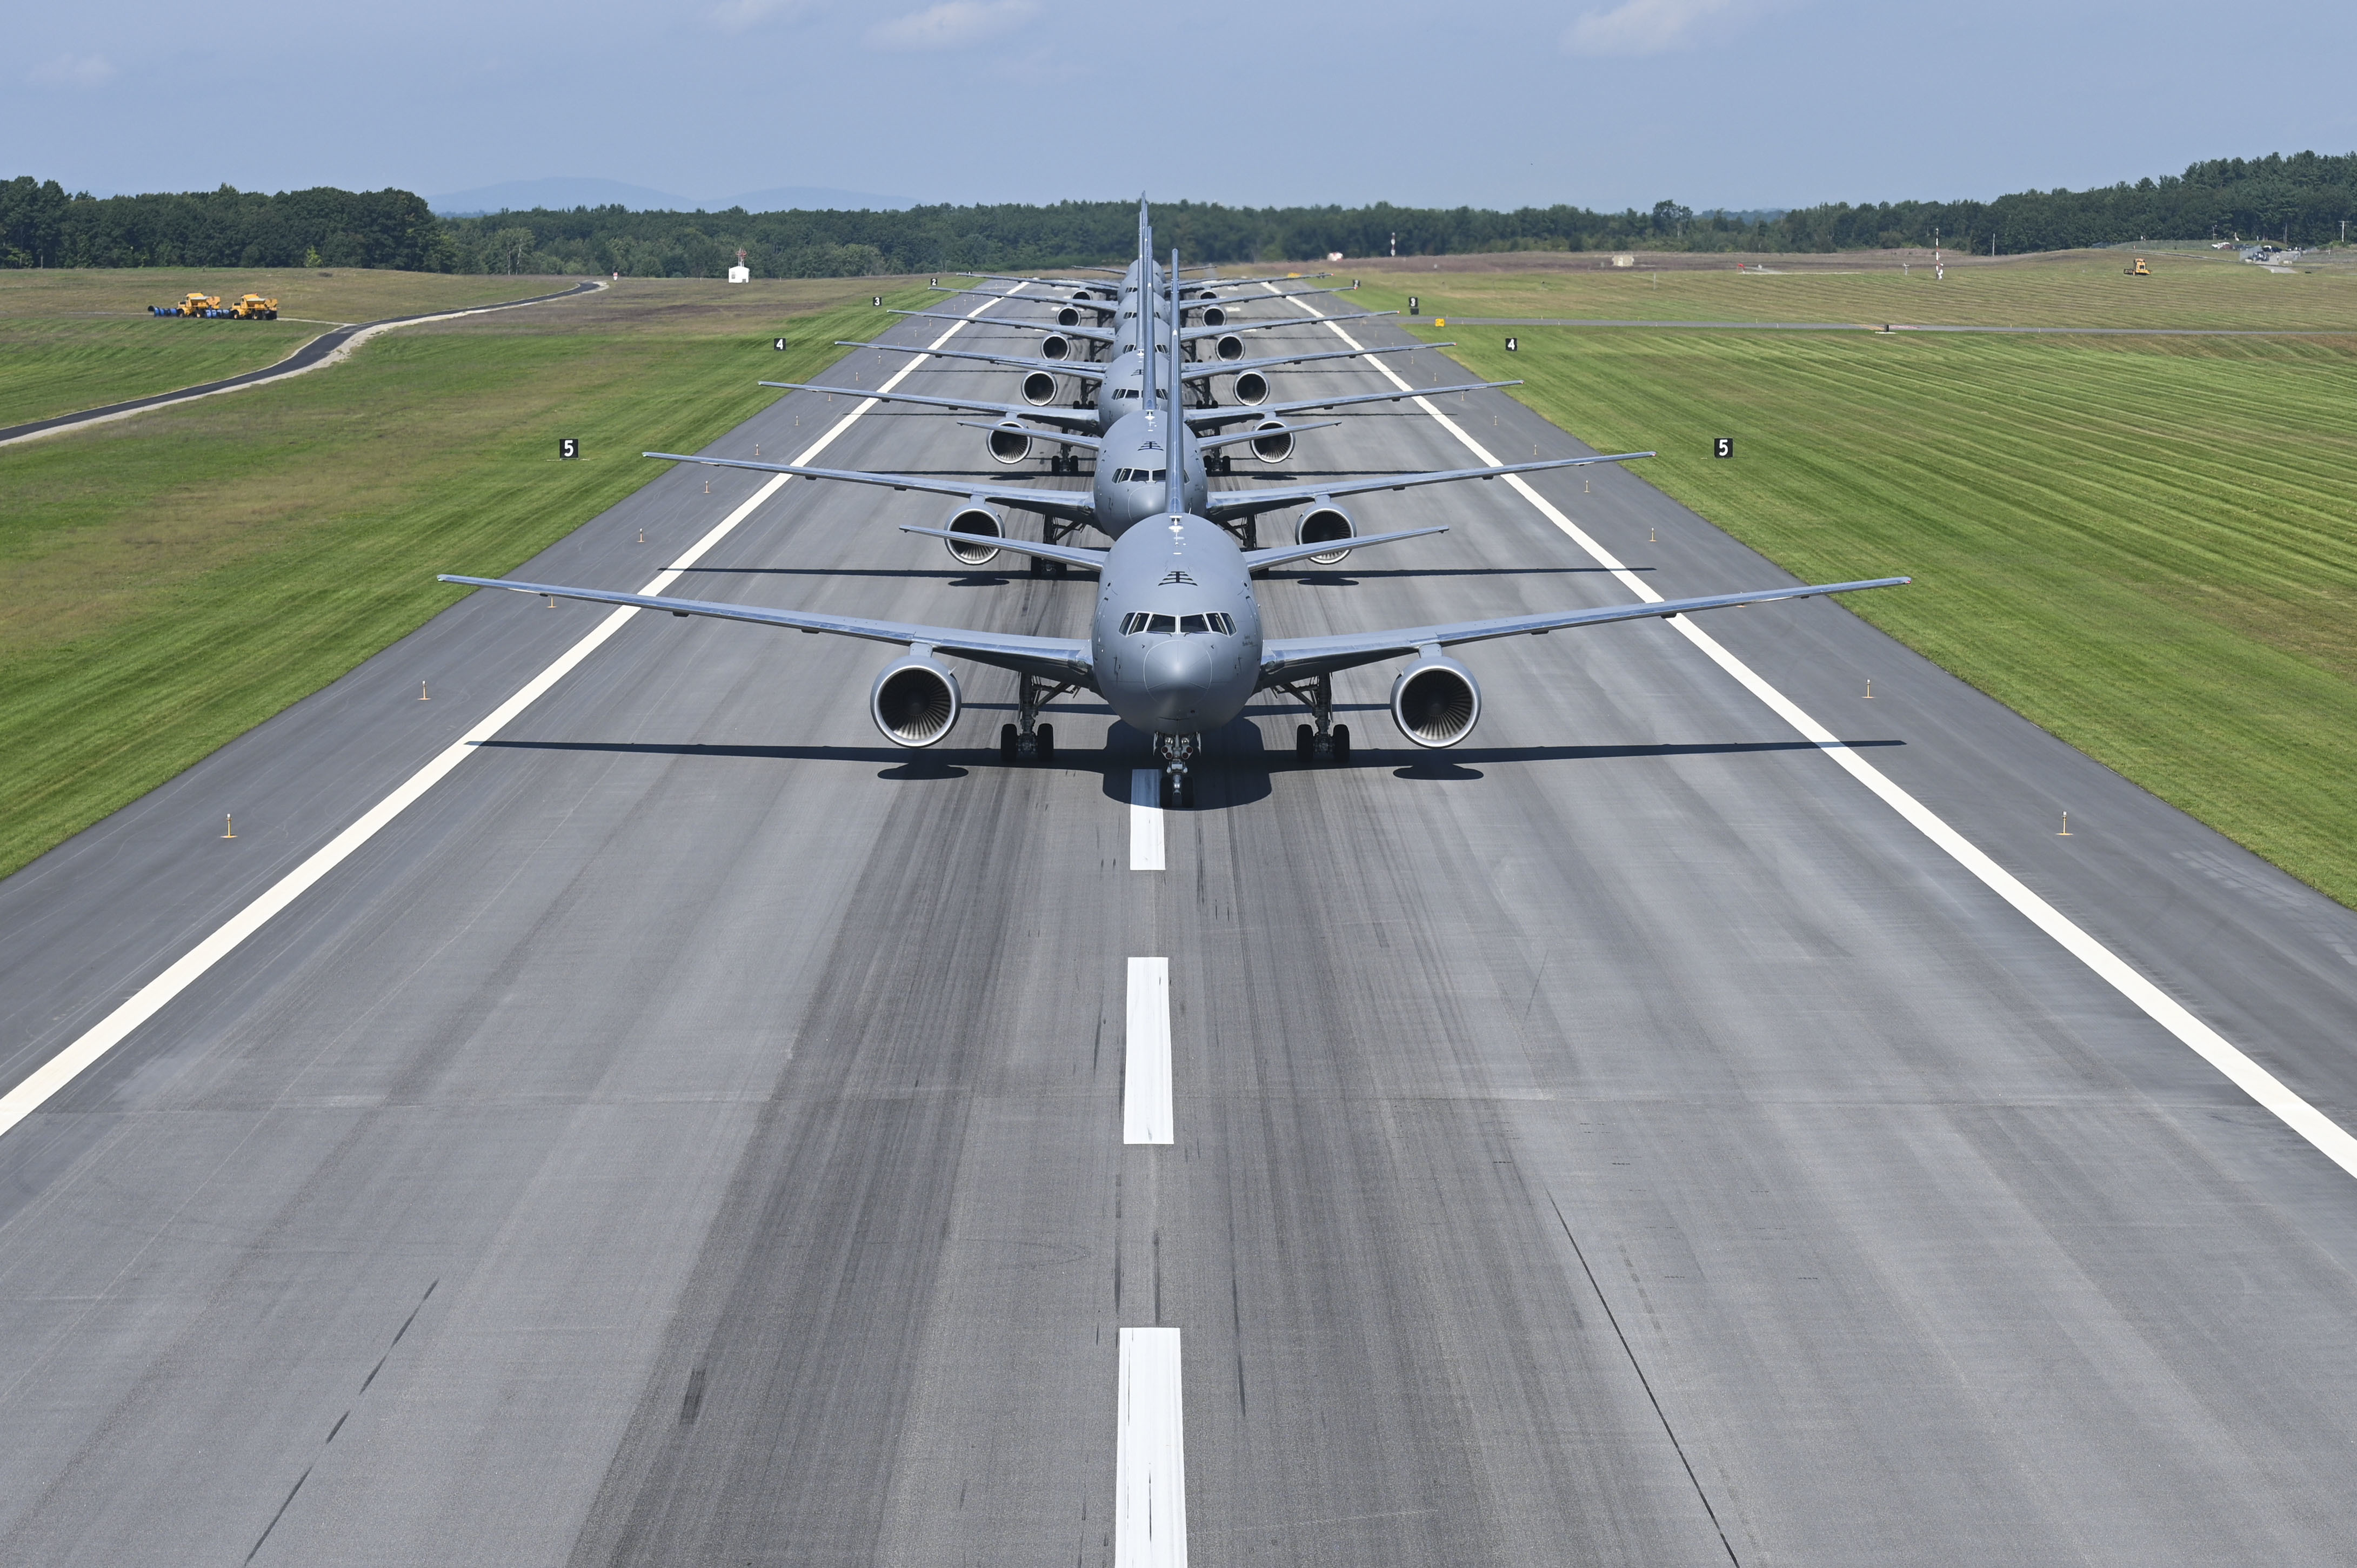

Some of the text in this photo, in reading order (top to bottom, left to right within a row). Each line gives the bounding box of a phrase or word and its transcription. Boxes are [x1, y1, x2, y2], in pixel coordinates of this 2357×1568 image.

[874, 297, 880, 306] 3
[1410, 298, 1415, 306] 3
[776, 338, 783, 350] 4
[1507, 339, 1515, 350] 4
[564, 440, 574, 457] 5
[1719, 439, 1728, 455] 5
